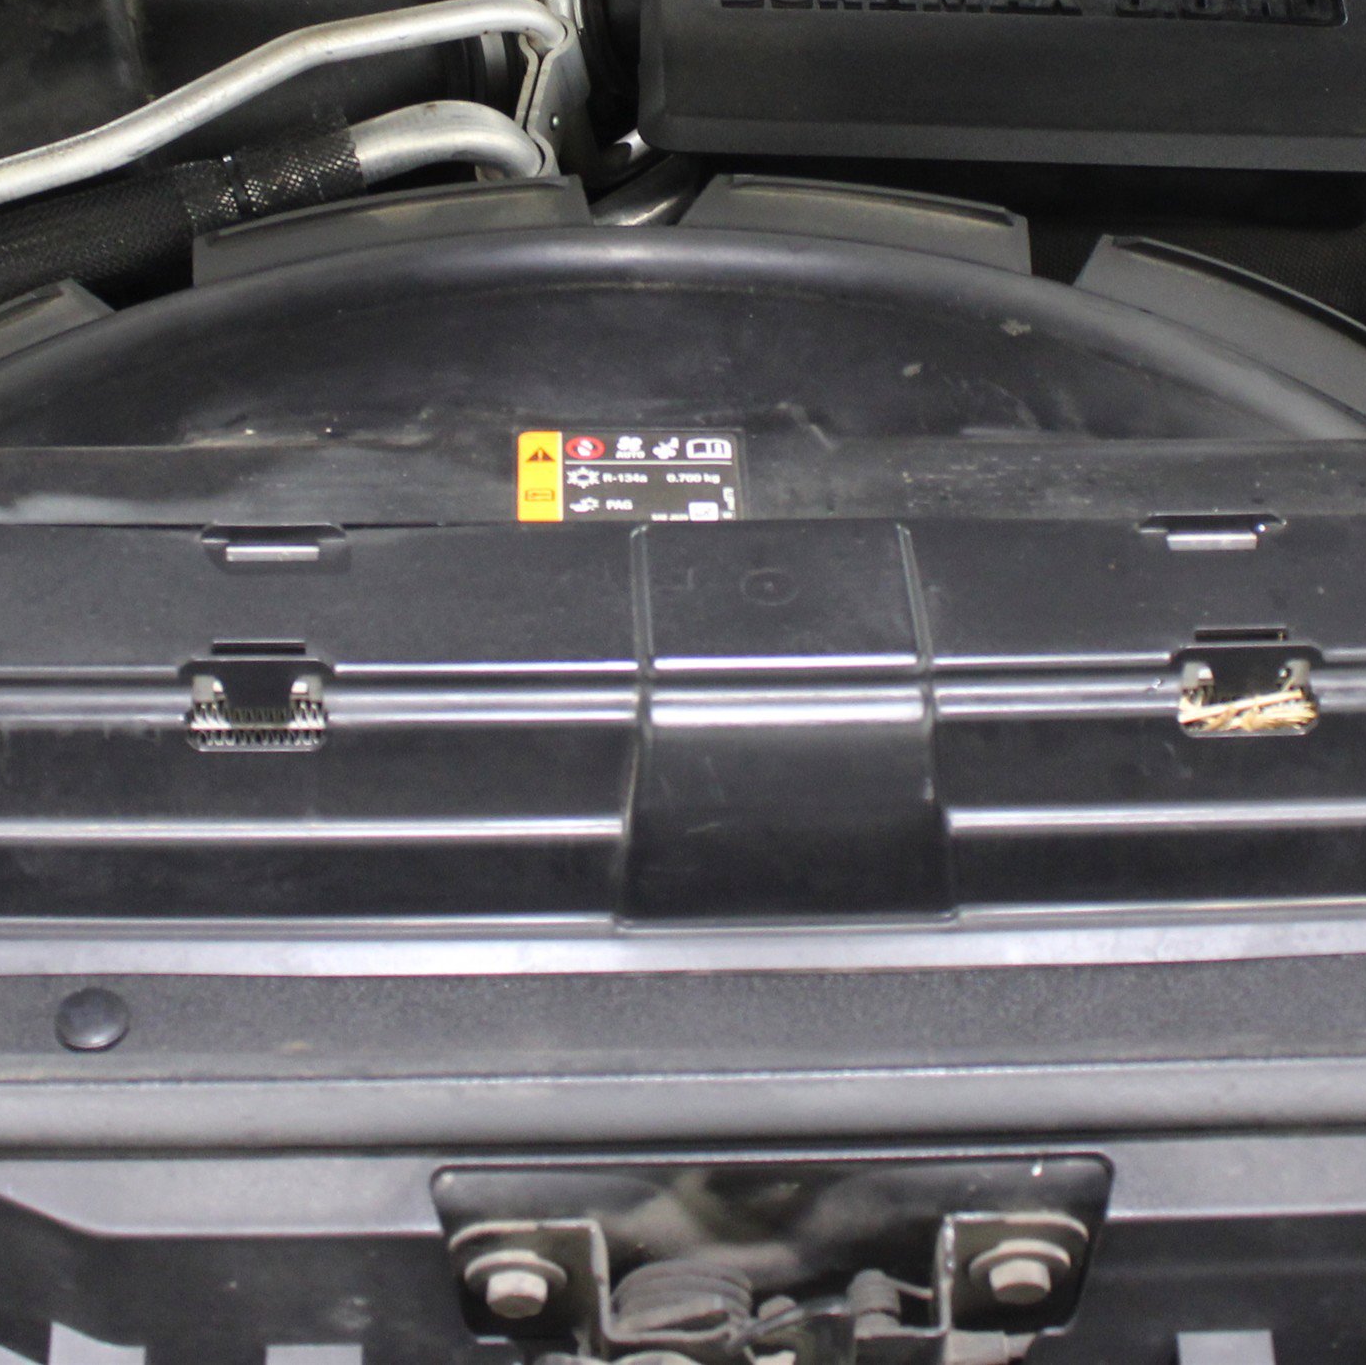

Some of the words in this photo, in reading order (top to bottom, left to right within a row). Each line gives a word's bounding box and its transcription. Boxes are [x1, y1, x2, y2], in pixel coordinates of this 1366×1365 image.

[602, 472, 648, 483] R-134a
[703, 472, 721, 485] kg
[605, 499, 633, 511] PAG
